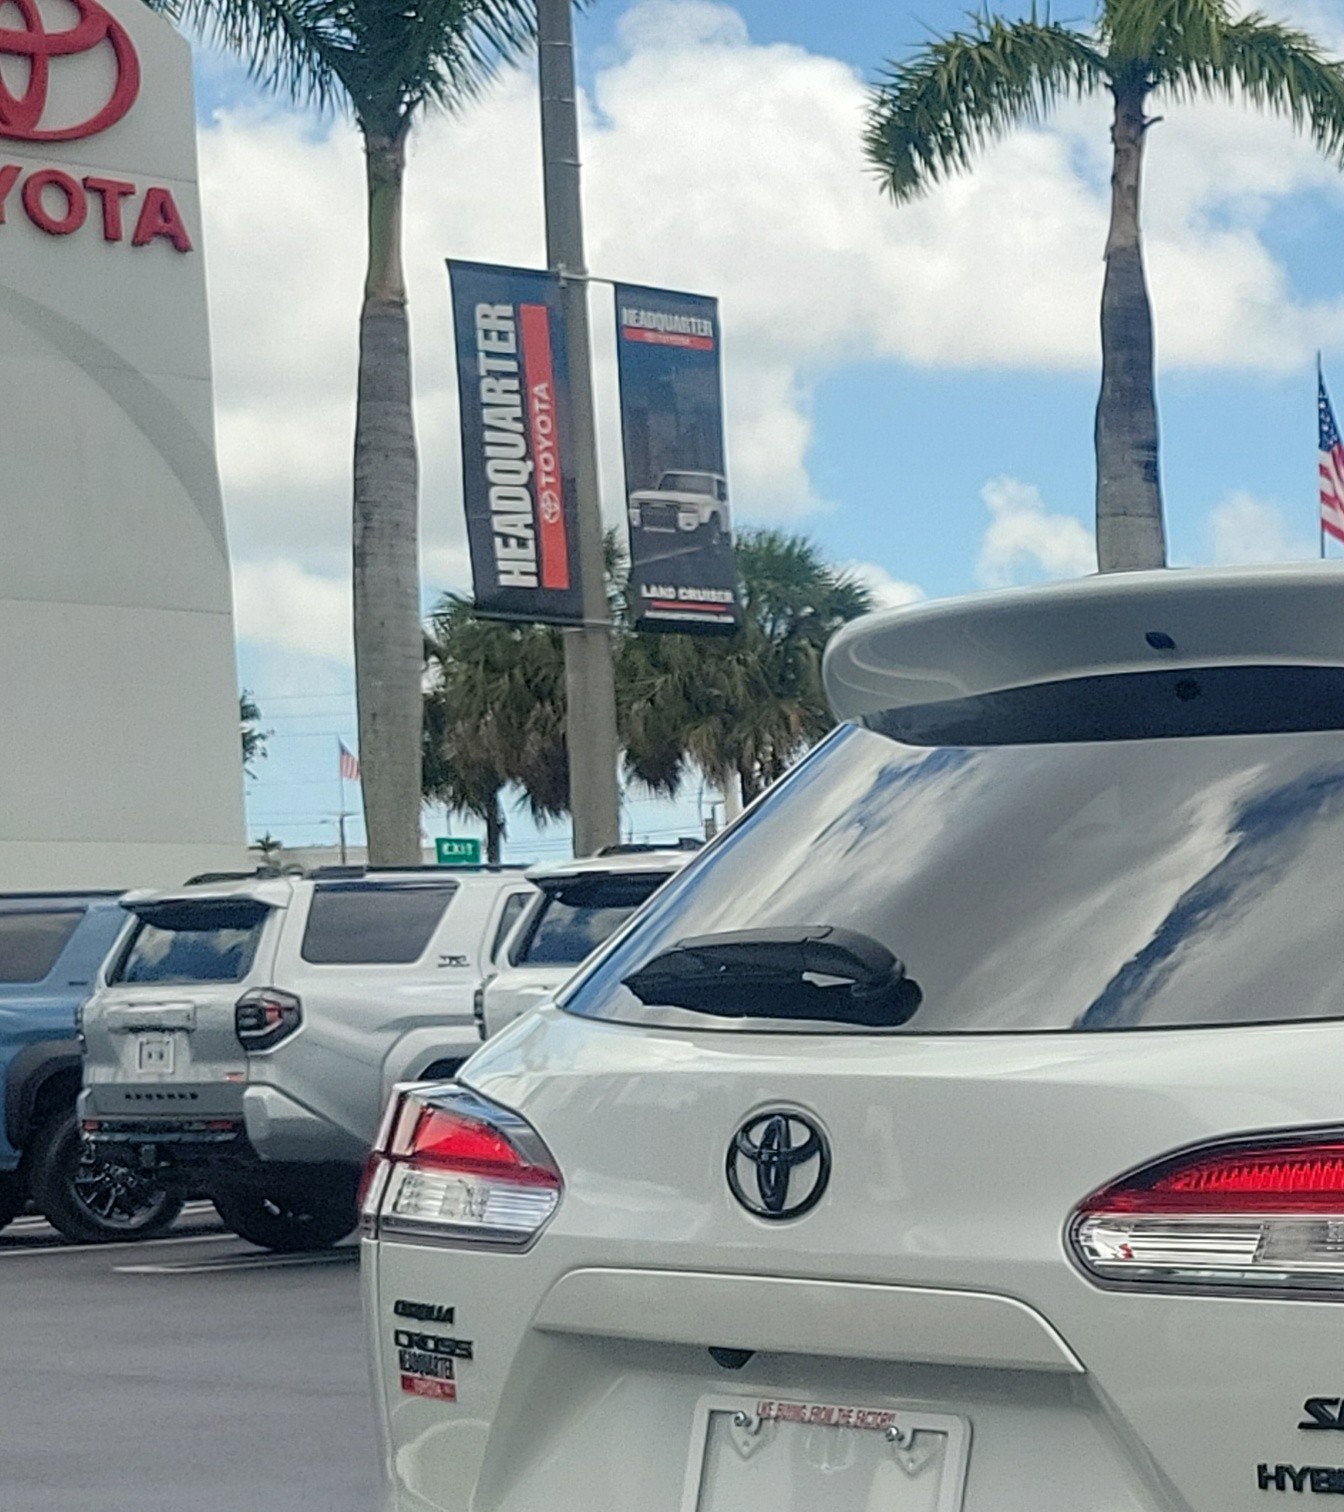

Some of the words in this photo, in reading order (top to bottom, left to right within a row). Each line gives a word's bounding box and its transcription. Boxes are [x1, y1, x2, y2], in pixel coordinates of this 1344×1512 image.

[474, 302, 538, 589] HEADQUARTER
[533, 382, 557, 486] TOYOTA
[641, 583, 676, 600] LAND
